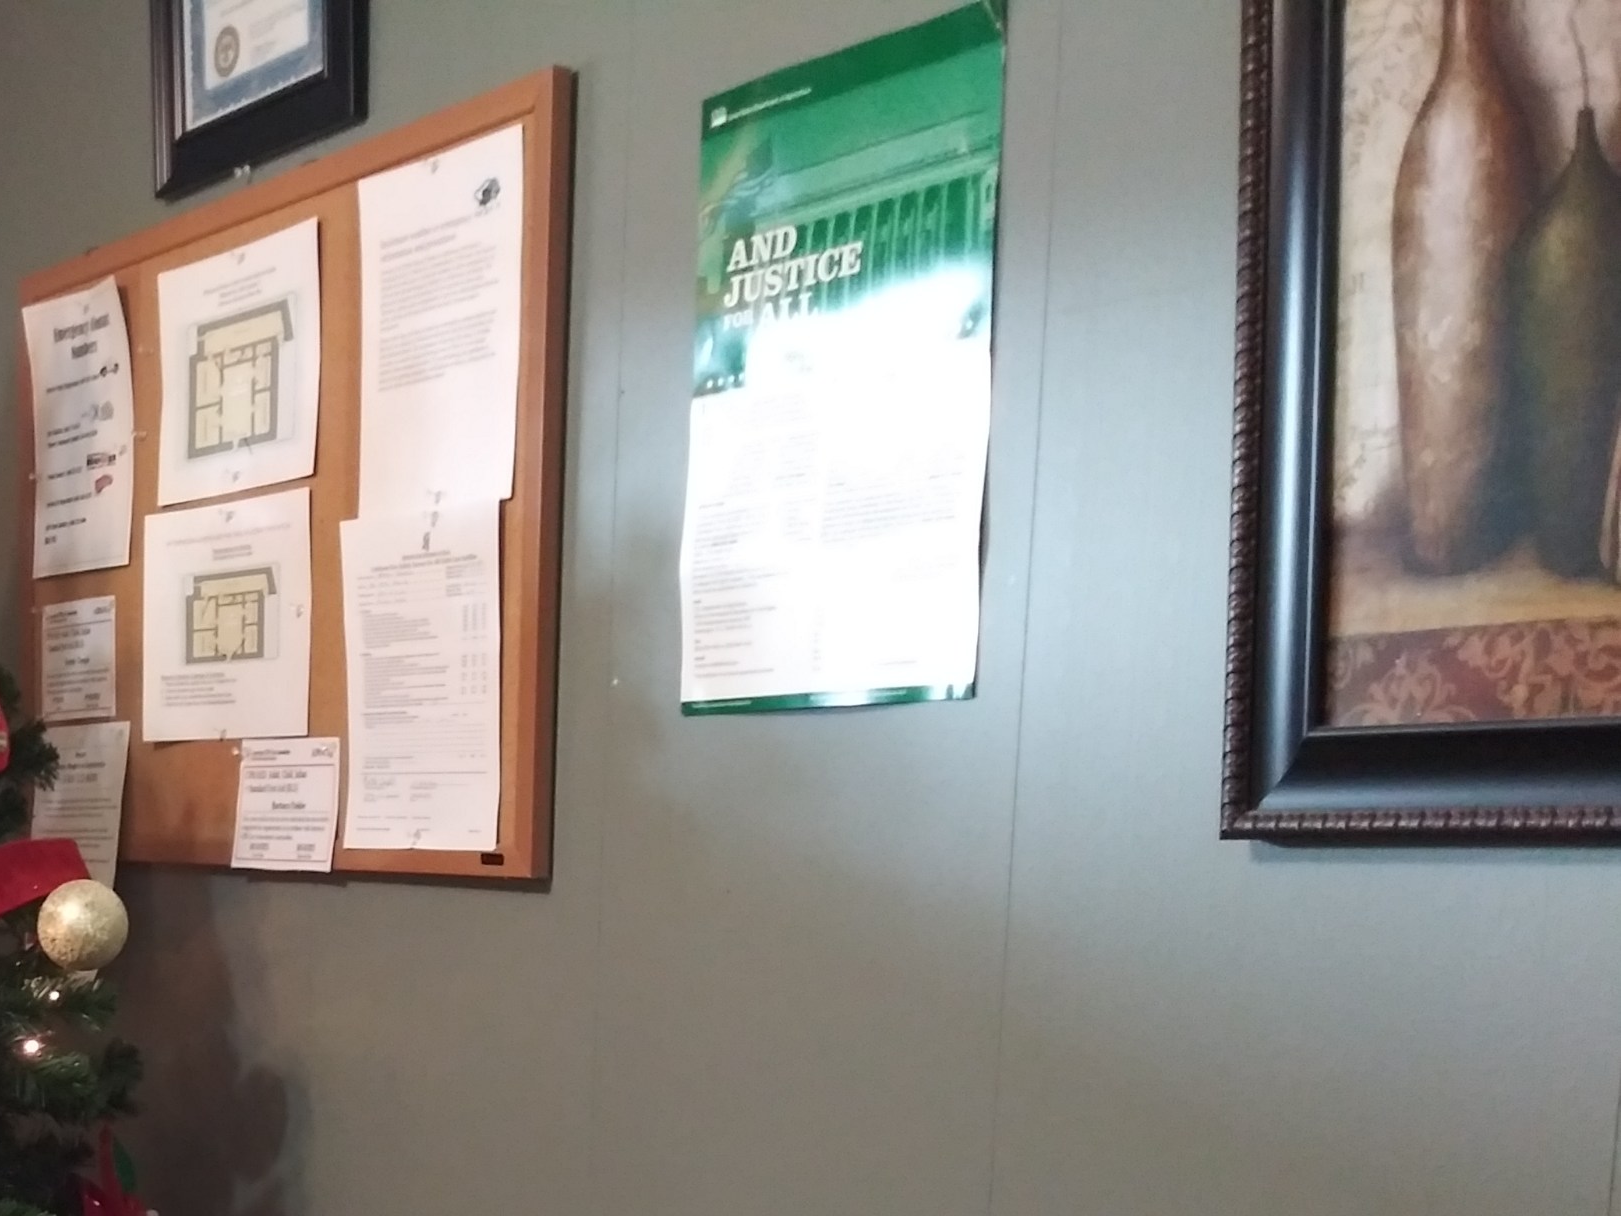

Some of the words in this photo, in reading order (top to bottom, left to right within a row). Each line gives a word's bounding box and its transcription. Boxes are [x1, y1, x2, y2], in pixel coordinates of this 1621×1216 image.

[726, 225, 797, 272] AND
[723, 241, 863, 308] JUSTICE
[723, 309, 754, 331] FOR
